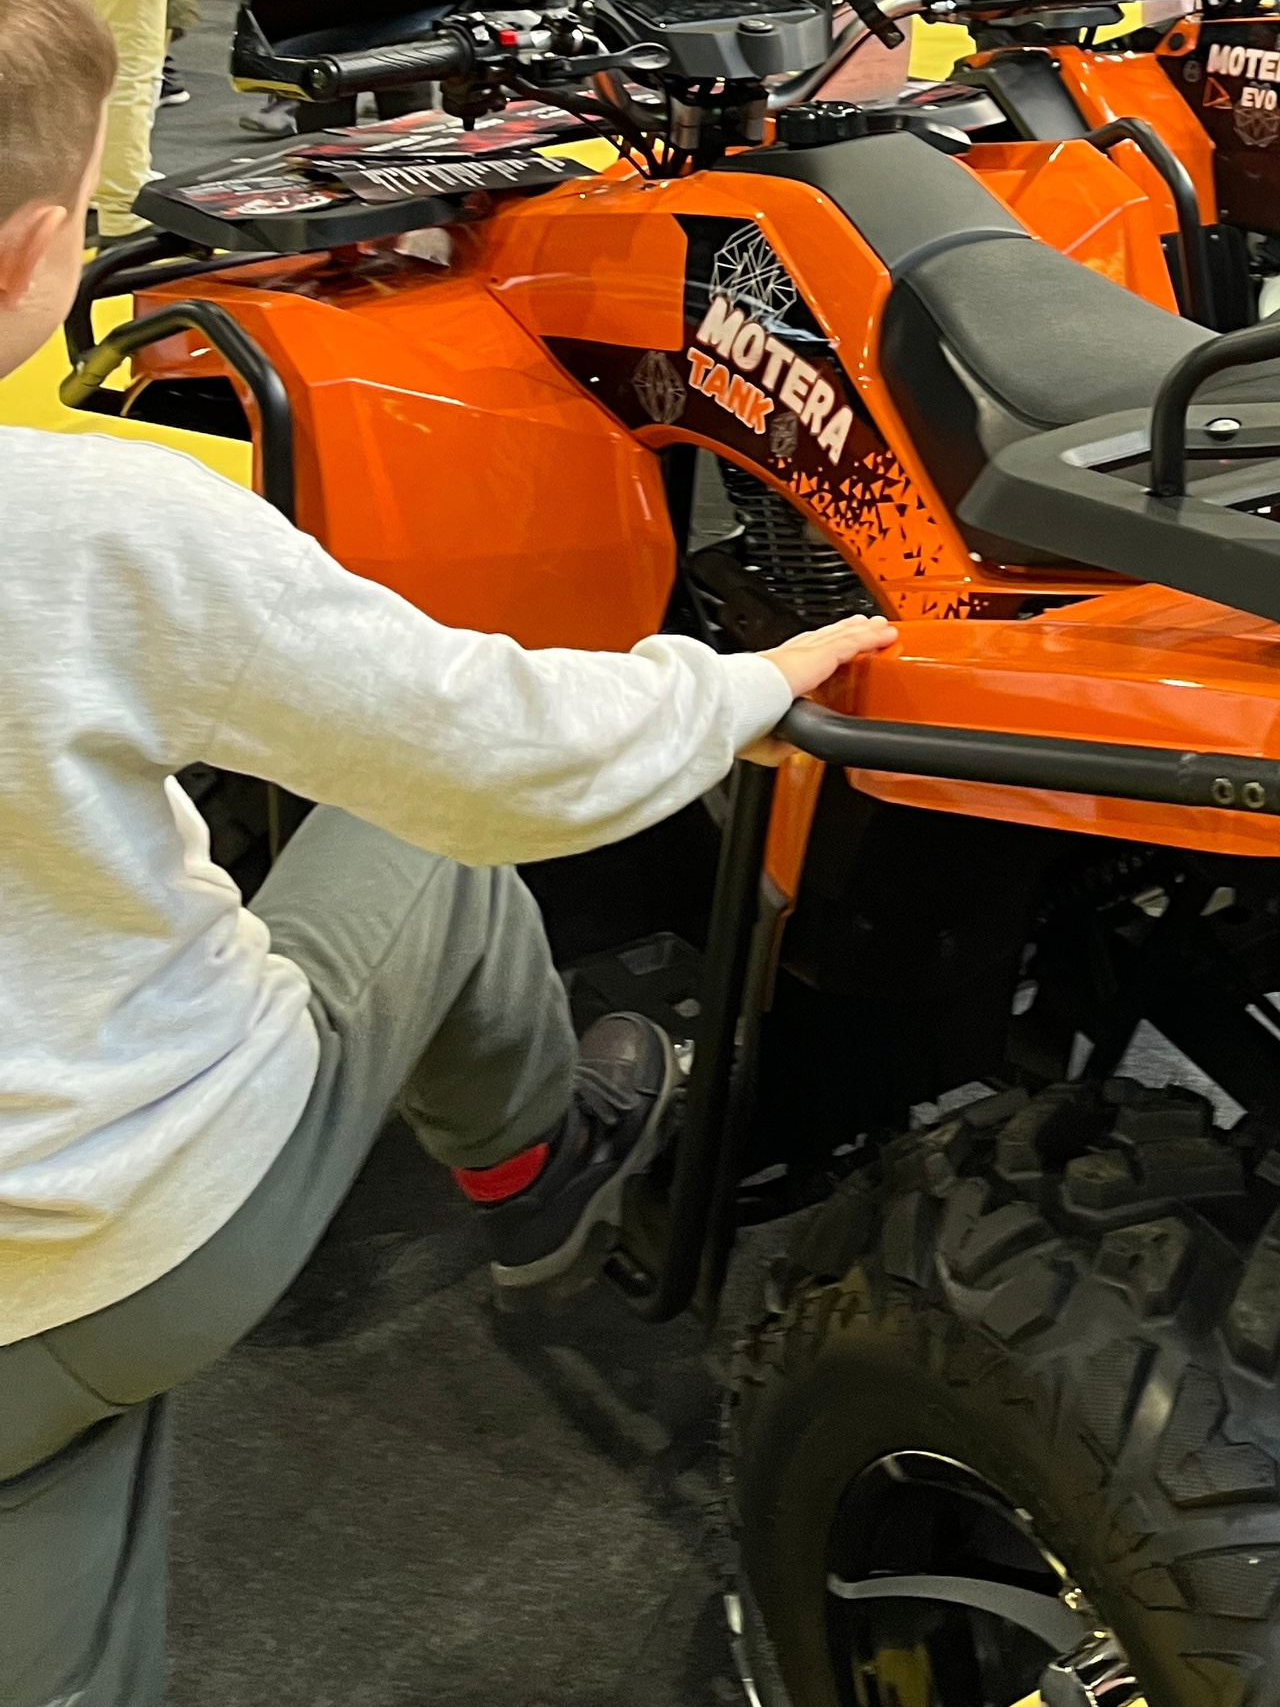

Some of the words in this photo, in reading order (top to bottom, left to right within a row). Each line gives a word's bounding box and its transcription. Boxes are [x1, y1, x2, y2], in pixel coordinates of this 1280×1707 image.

[1241, 86, 1278, 111] EVO
[687, 347, 774, 435] TANK
[696, 295, 854, 466] MOTERA
